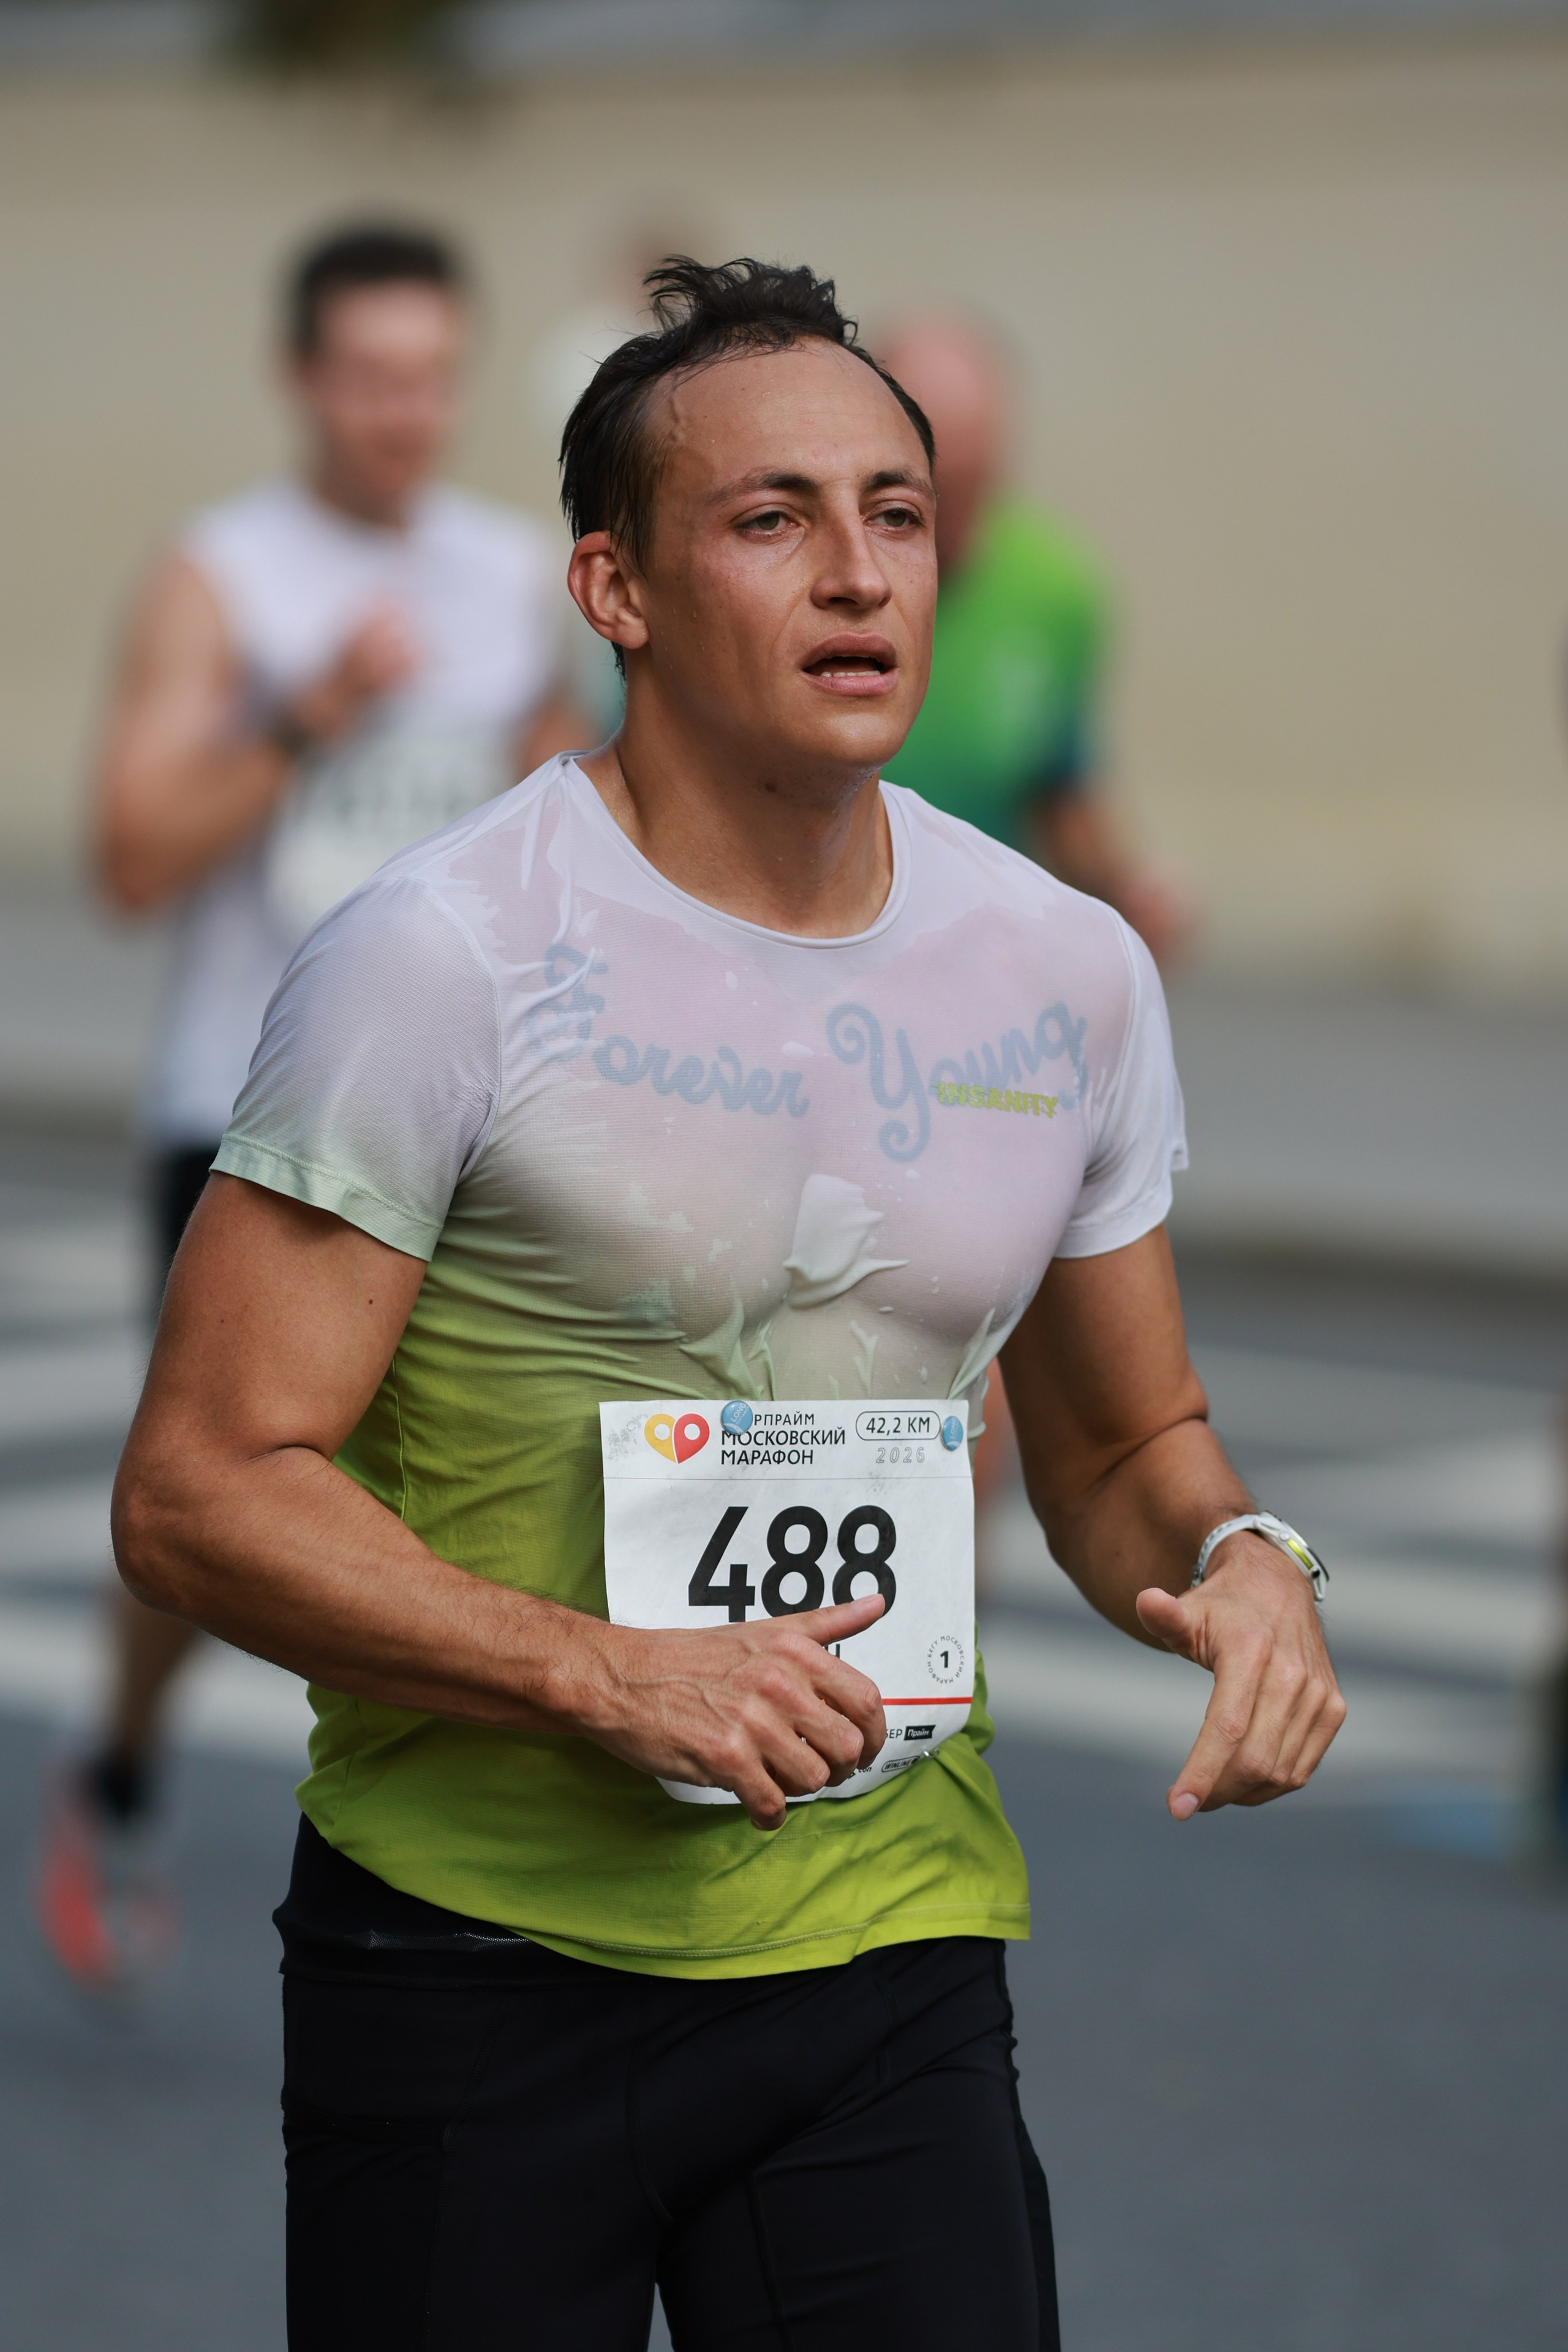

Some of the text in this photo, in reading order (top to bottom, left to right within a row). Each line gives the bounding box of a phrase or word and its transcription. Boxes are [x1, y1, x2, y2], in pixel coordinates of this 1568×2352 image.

[525, 943, 1087, 1163] Forever Young
[932, 1081, 1058, 1118] INSANITY
[730, 1402, 747, 1423] LONG
[754, 1411, 815, 1426] РПРАЙМ
[722, 1426, 845, 1446] МОСКОВСКИЙ
[866, 1417, 901, 1436] 42,2
[721, 1449, 813, 1465] МАРАФОН
[876, 1447, 924, 1463] 2026
[688, 1504, 896, 1623] 488
[940, 1635, 965, 1678] МОСКОВСКИЙ
[940, 1650, 949, 1668] 1
[927, 1661, 954, 1684] МАРАФОН
[907, 1728, 930, 1738] Прайм
[884, 1760, 911, 1770] WINLINE
